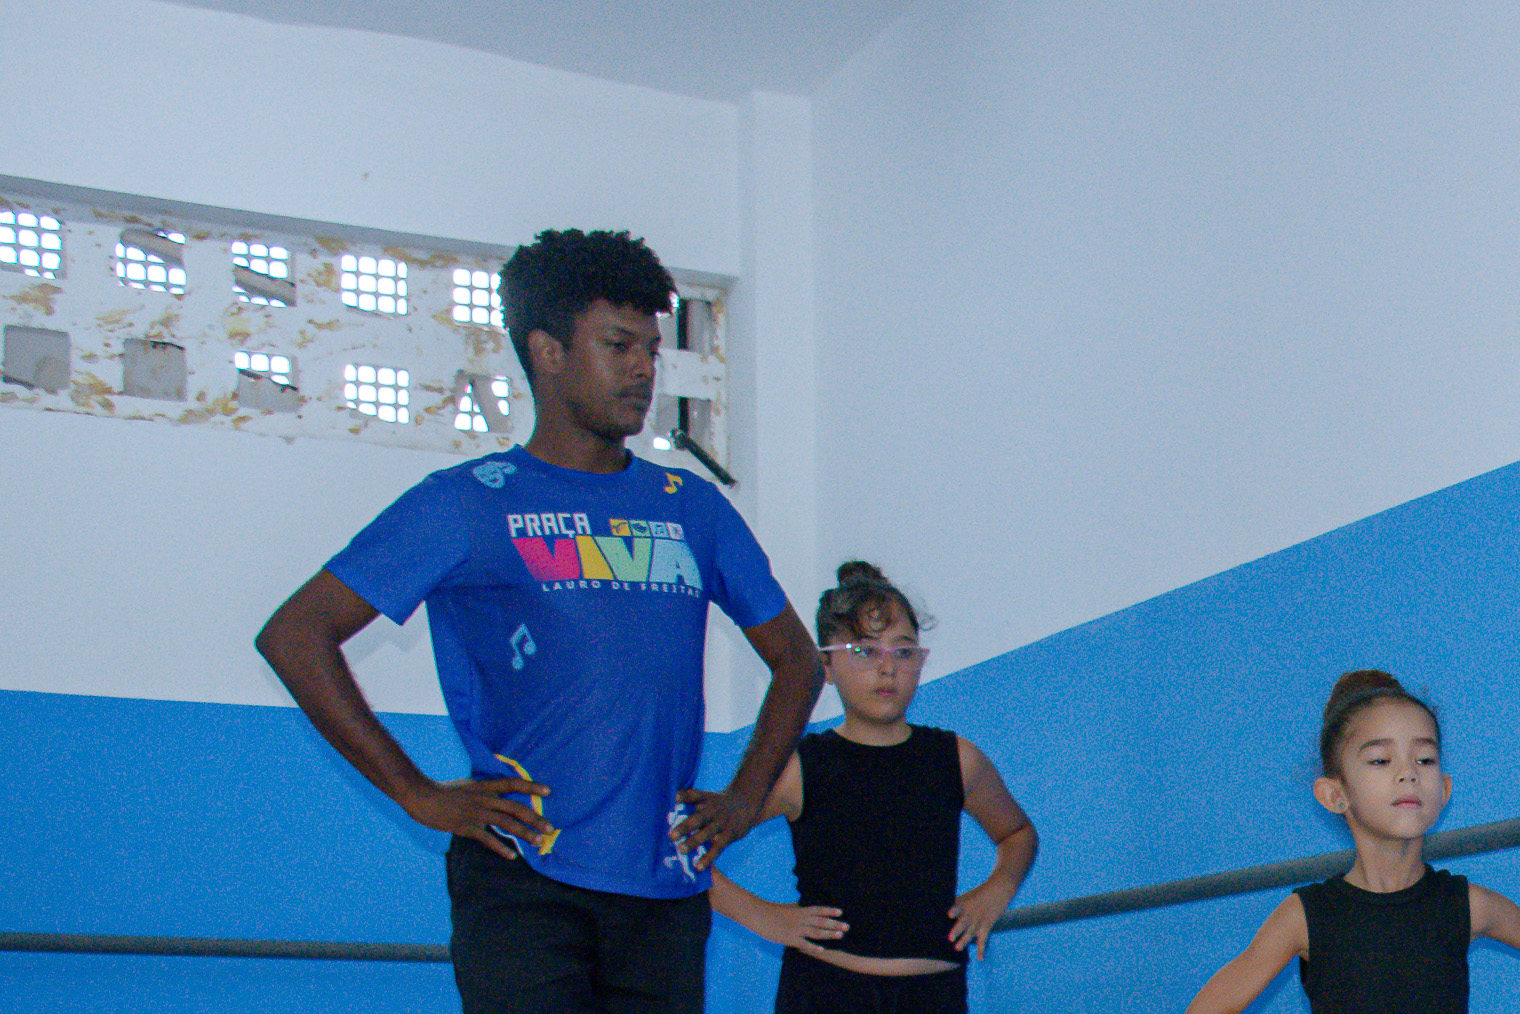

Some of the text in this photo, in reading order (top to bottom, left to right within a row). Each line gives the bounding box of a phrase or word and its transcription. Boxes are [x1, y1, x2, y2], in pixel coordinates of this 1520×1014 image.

[507, 513, 593, 538] PRAÇA
[511, 535, 703, 591] VIVA
[541, 581, 701, 599] LAURO DE FREITAS
